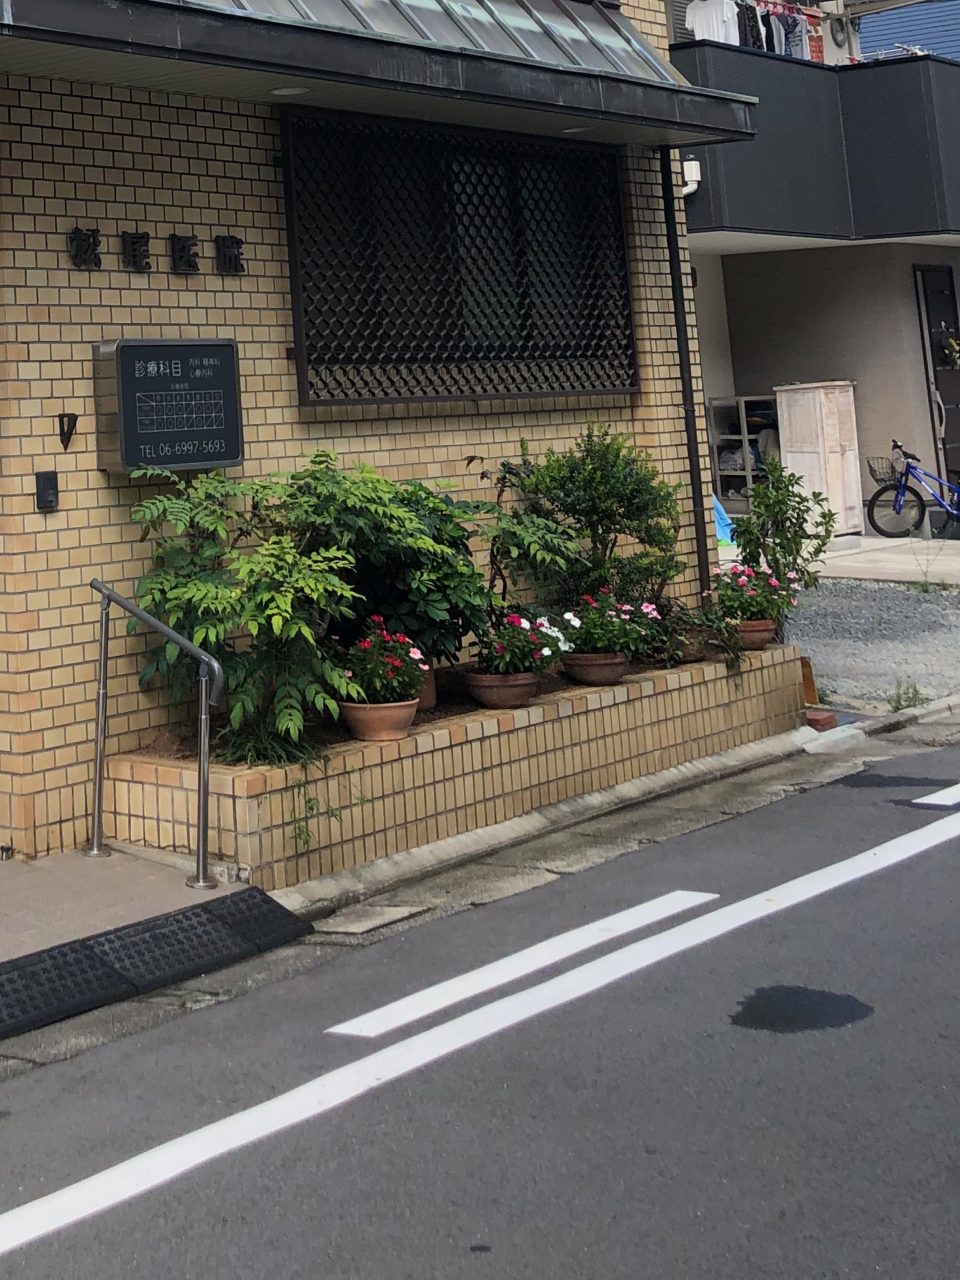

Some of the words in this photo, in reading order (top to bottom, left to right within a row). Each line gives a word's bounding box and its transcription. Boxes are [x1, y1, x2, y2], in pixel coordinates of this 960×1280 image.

[135, 360, 181, 377] 診療科目
[140, 445, 156, 458] TEL
[159, 440, 225, 456] 06-6997-5693
